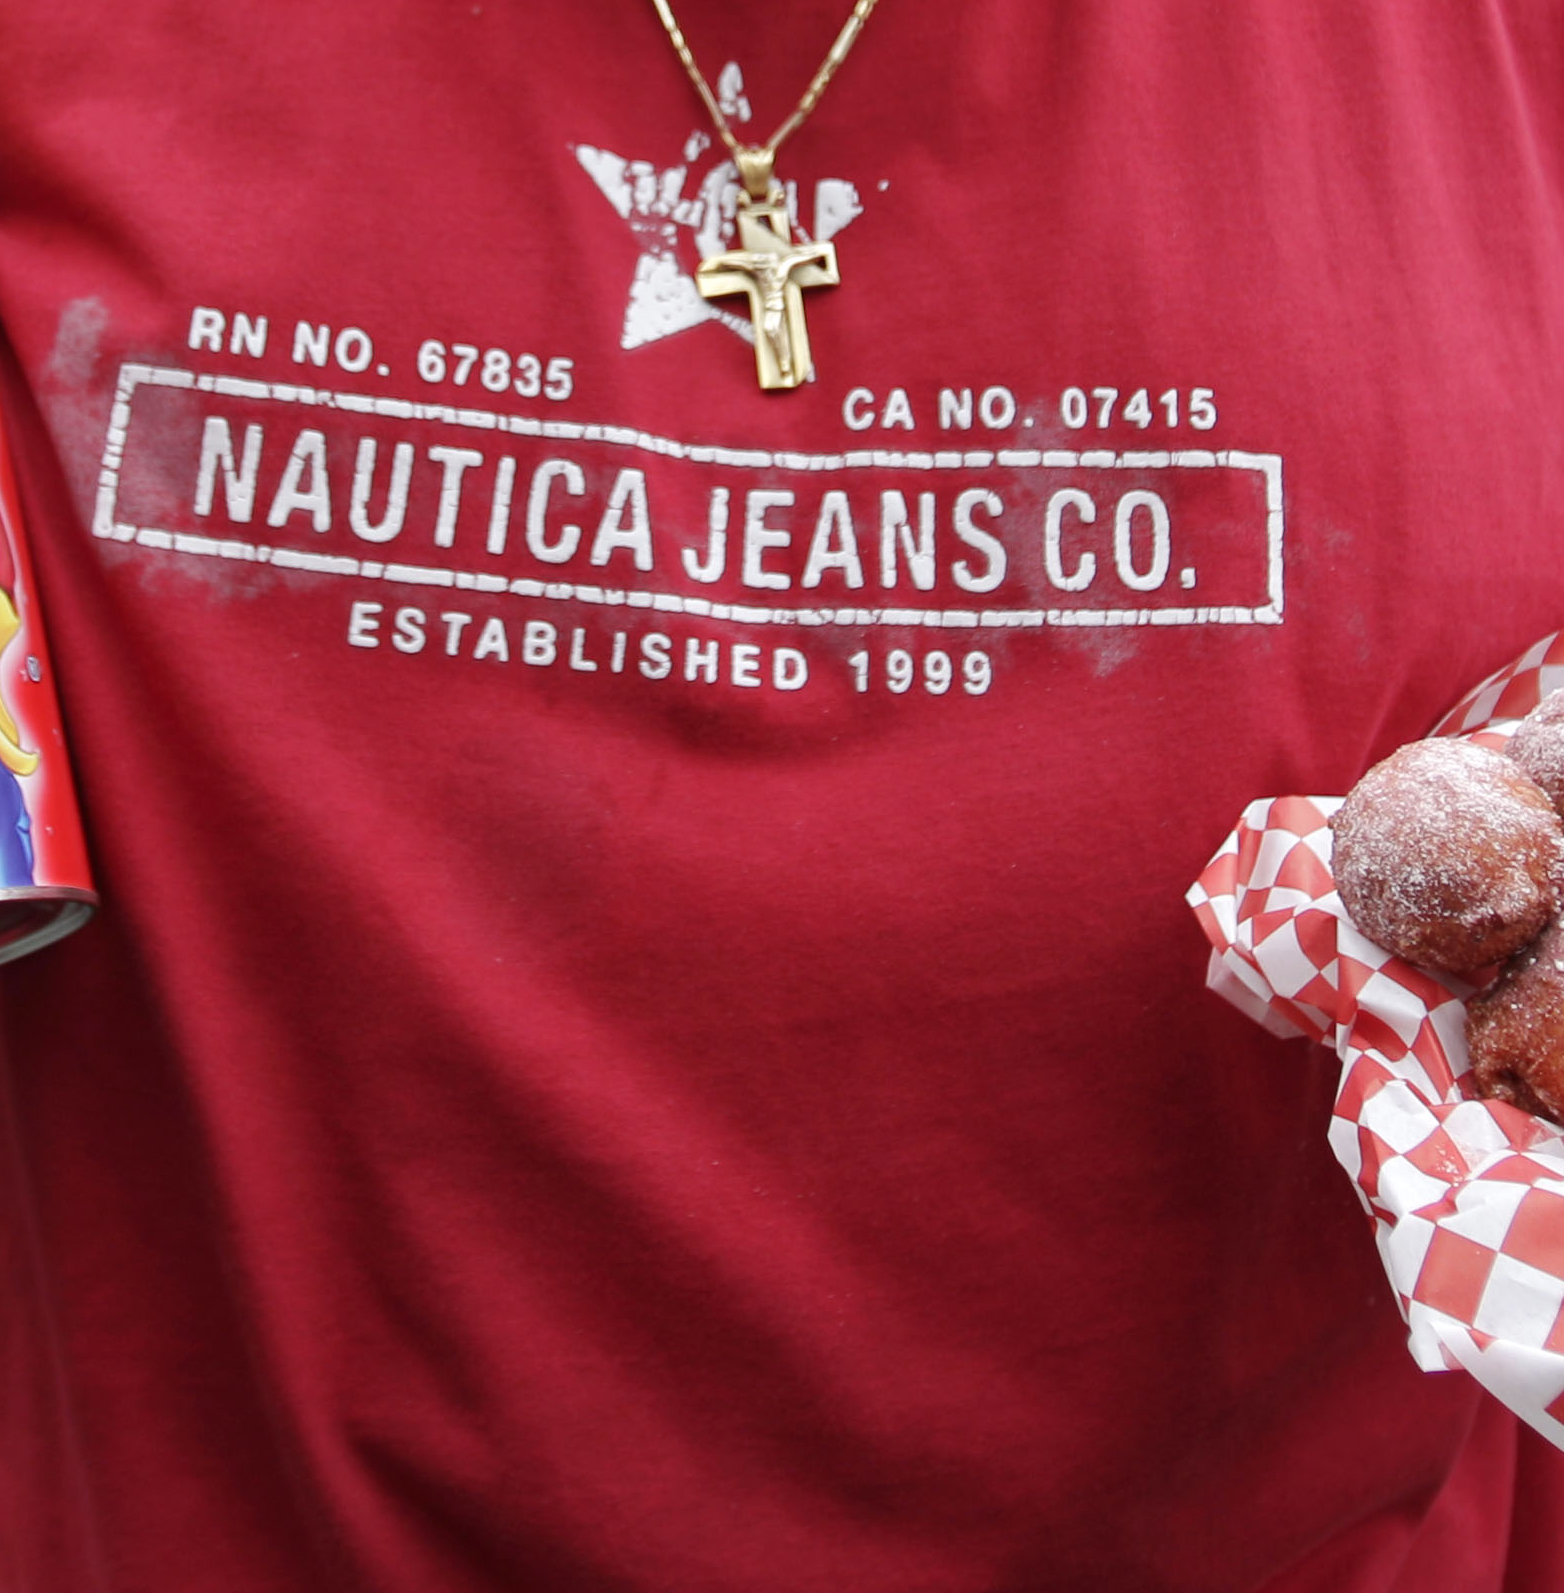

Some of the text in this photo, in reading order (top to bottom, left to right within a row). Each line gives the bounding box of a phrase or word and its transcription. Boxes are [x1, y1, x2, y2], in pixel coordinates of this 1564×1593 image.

[187, 306, 575, 402] RN NO. 67835
[842, 386, 1218, 431] CA NO. 07415
[192, 415, 1197, 594] NAUTICA JEANS CO.
[347, 600, 993, 696] ESTABLISHED 1999
